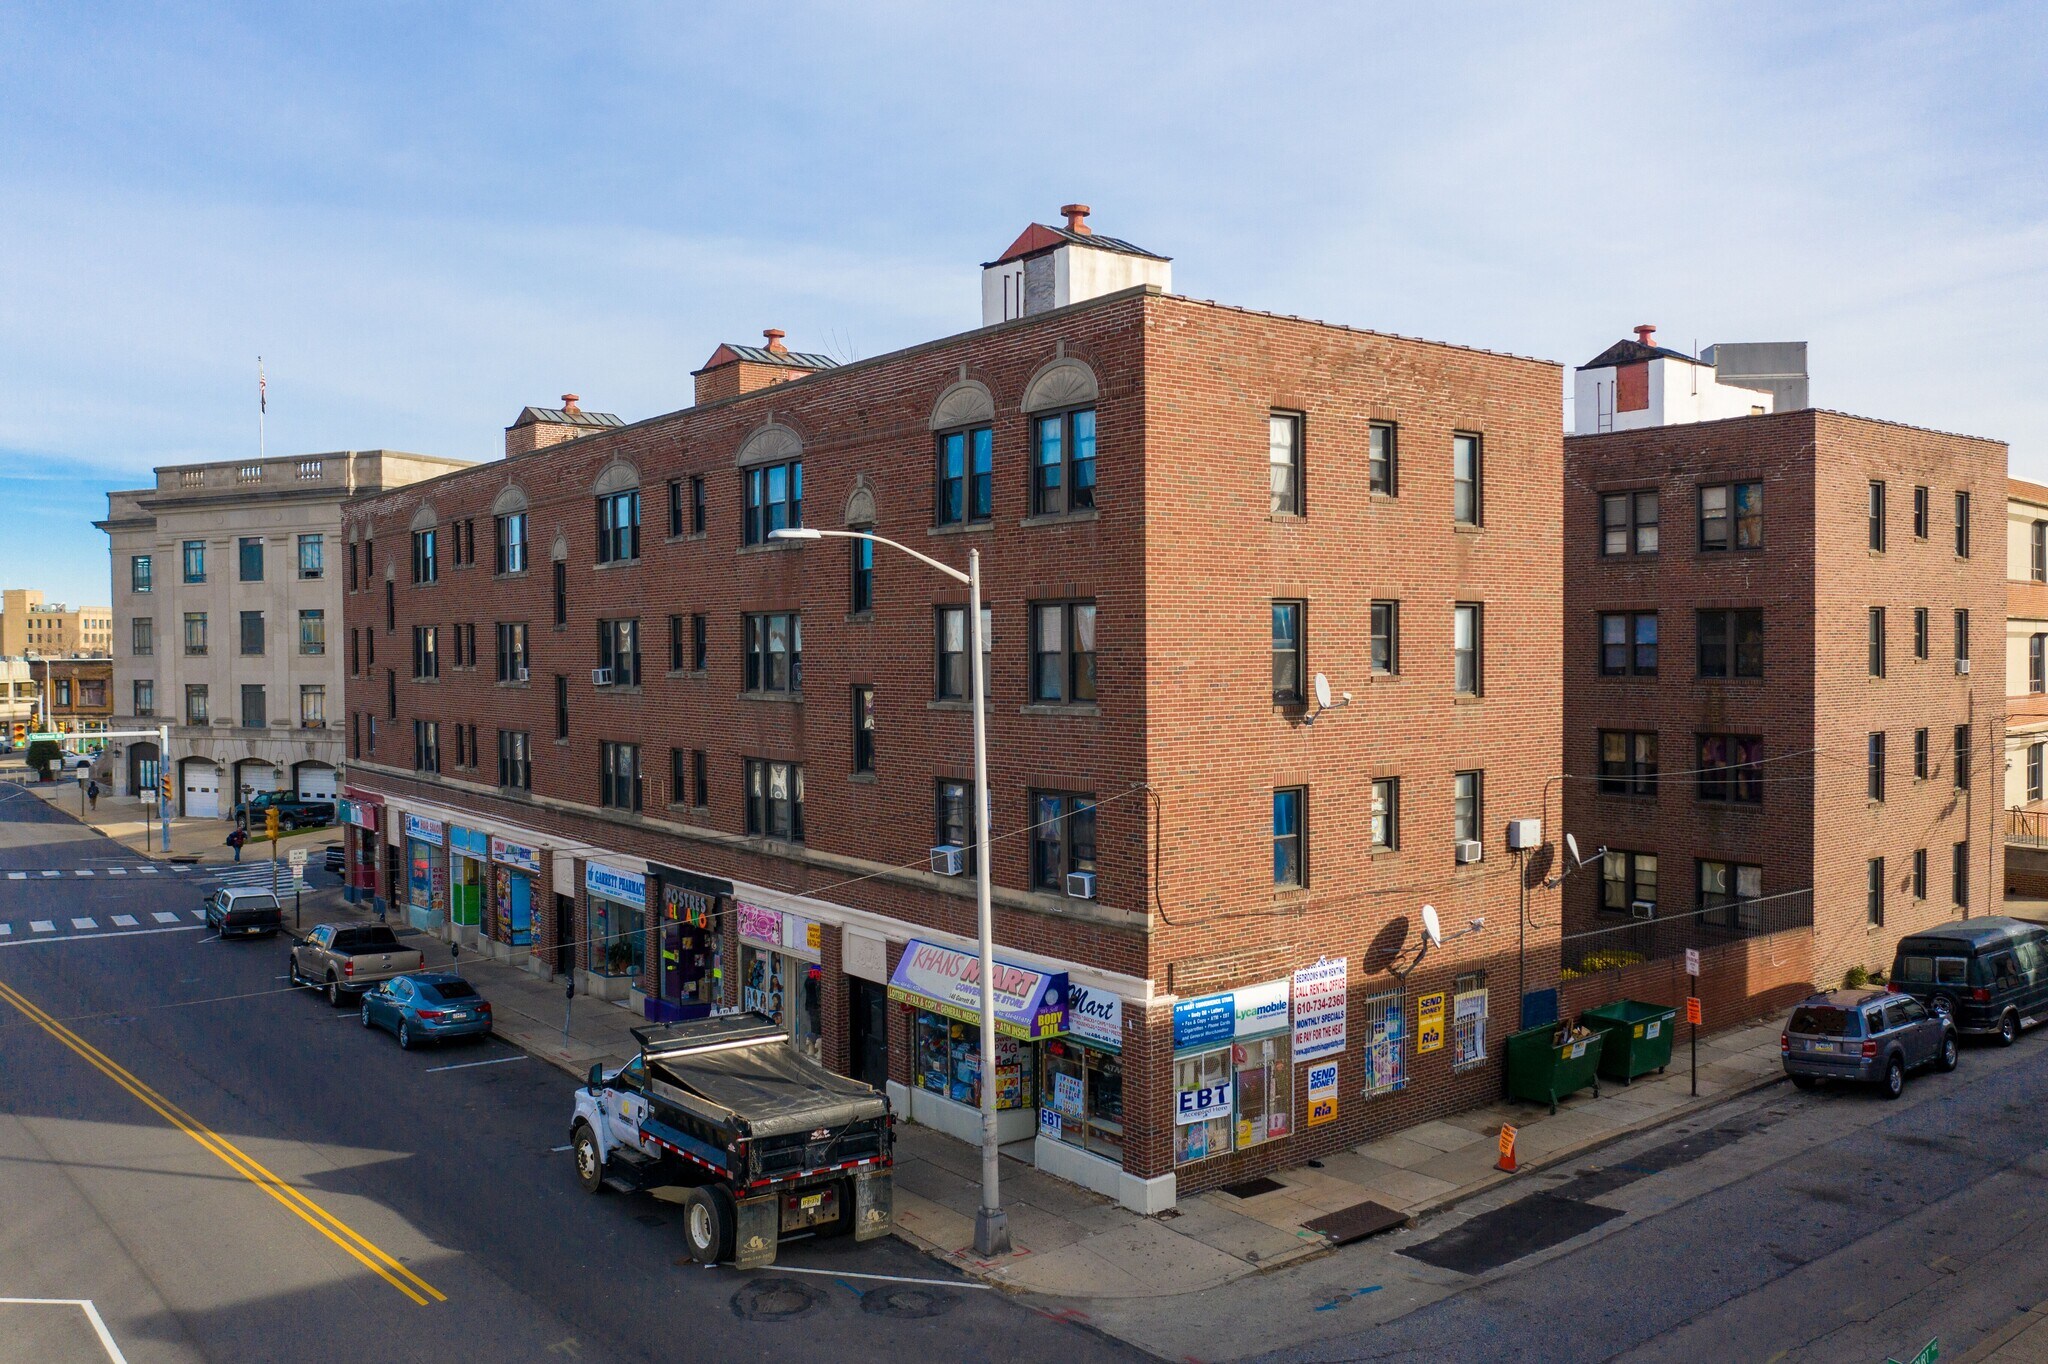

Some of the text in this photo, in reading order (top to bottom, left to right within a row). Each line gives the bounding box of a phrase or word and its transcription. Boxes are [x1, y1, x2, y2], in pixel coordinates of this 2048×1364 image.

[595, 870, 618, 890] GARRETT
[618, 876, 645, 897] PHARMACY
[665, 887, 706, 914] POSTRES
[668, 902, 678, 920] EL
[912, 946, 965, 977] KHAN'S
[1296, 971, 1319, 983] BEDROOMS
[1320, 968, 1328, 979] NOW
[1328, 965, 1345, 978] RENTING
[1295, 978, 1345, 998] CALL RENTAL OFFICE
[889, 987, 908, 1001] LOTTERY
[910, 994, 920, 1005] FAX
[925, 999, 938, 1010] COPY
[940, 1004, 961, 1019] GENERAL
[999, 1022, 1011, 1034] ATM
[1000, 995, 1025, 1009] STORE
[1068, 984, 1114, 1020] Mart
[1236, 1000, 1287, 1020] Lycamobile
[1296, 994, 1345, 1015] 610-734-2360
[1420, 995, 1442, 1008] SEND
[1420, 1005, 1441, 1016] MONEY
[1038, 1011, 1063, 1027] BODY
[1296, 1010, 1345, 1030] MONTHLY SPECIALS
[1041, 1023, 1058, 1036] OIL
[1295, 1023, 1343, 1044] WE PAY FOR THE HEAT
[1421, 1027, 1439, 1044] Ria
[1310, 1067, 1336, 1082] SEND
[1310, 1077, 1336, 1090] MONEY
[1180, 1083, 1230, 1112] EBT
[1041, 1108, 1061, 1128] EBT
[1183, 1105, 1228, 1119] Accepted Here
[1313, 1102, 1331, 1118] Ria
